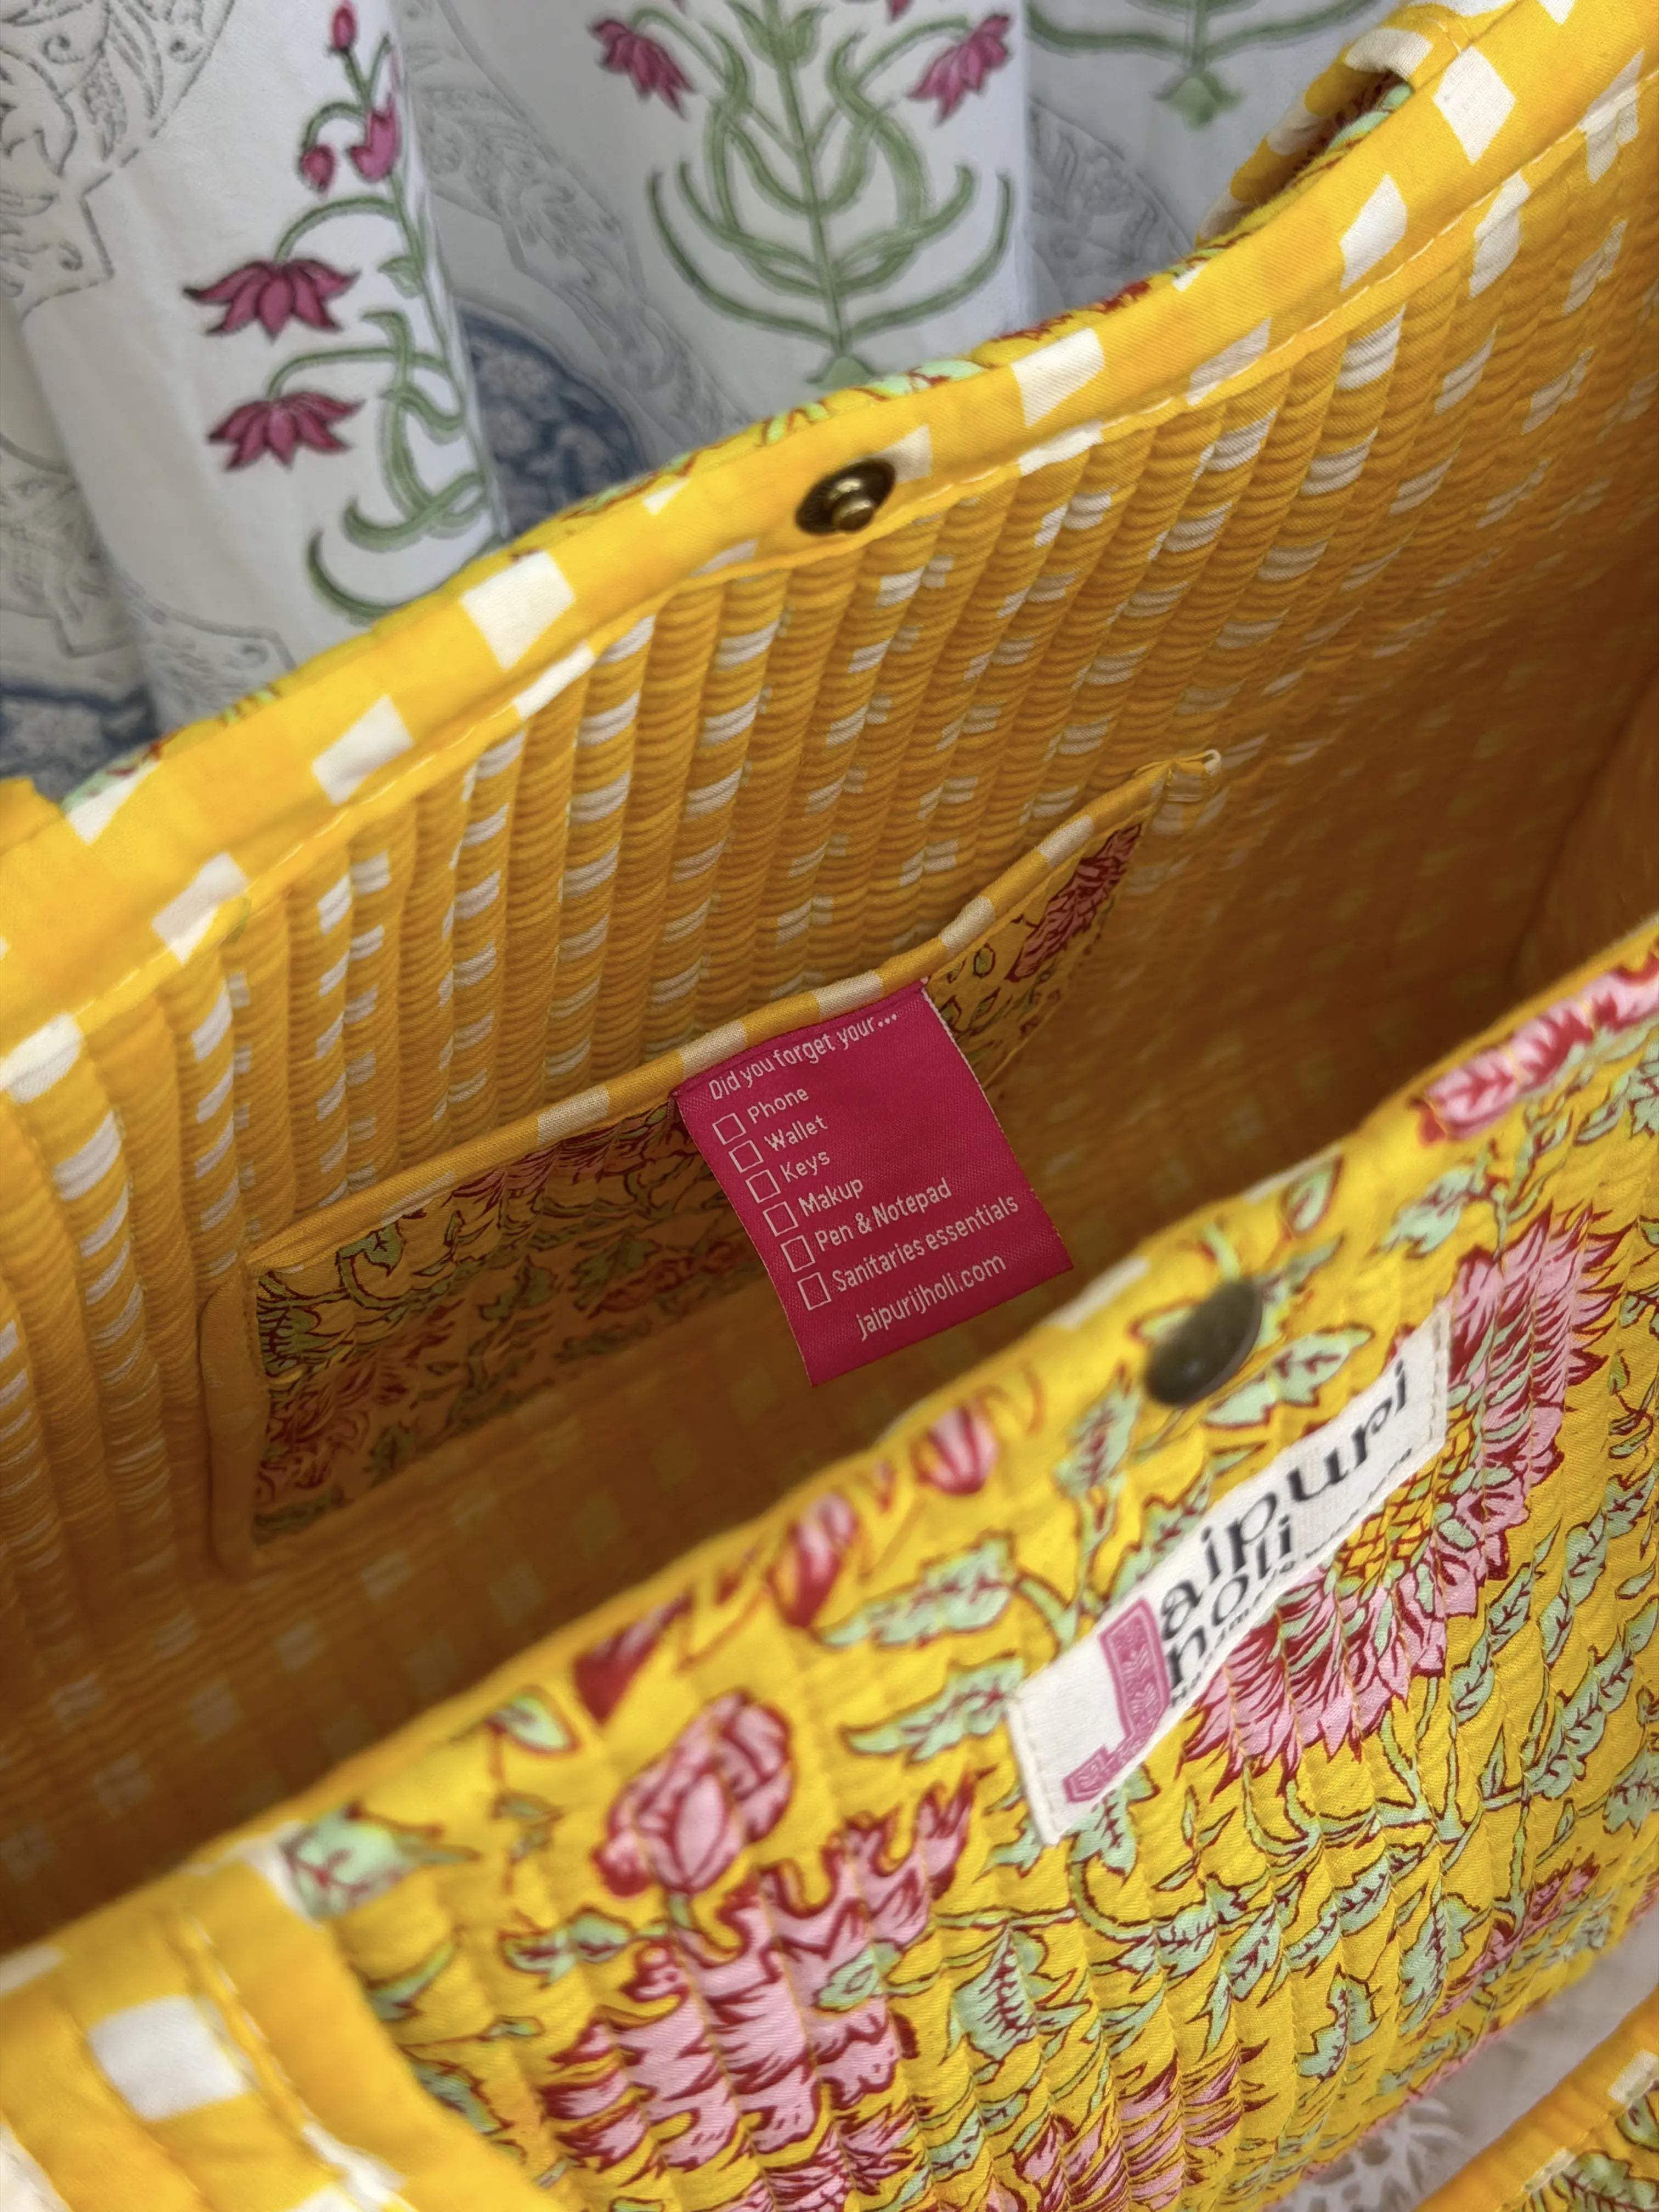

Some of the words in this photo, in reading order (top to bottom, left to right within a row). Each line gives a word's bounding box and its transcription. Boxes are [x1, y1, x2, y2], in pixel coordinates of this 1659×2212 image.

[708, 1070, 741, 1101] Did
[741, 1057, 775, 1088] you
[772, 1033, 836, 1067] forget
[837, 1013, 898, 1051] your...
[747, 1088, 809, 1124] Phone
[763, 1114, 828, 1152] Wallet
[780, 1151, 831, 1183] Keys
[798, 1179, 864, 1217] Makup
[814, 1225, 854, 1251] Pen
[855, 1212, 872, 1234] &
[871, 1176, 952, 1228] Notepad
[832, 1239, 925, 1292] Sanitaries
[926, 1196, 1019, 1251] essentials
[856, 1255, 1007, 1342] jaipurijholi.com
